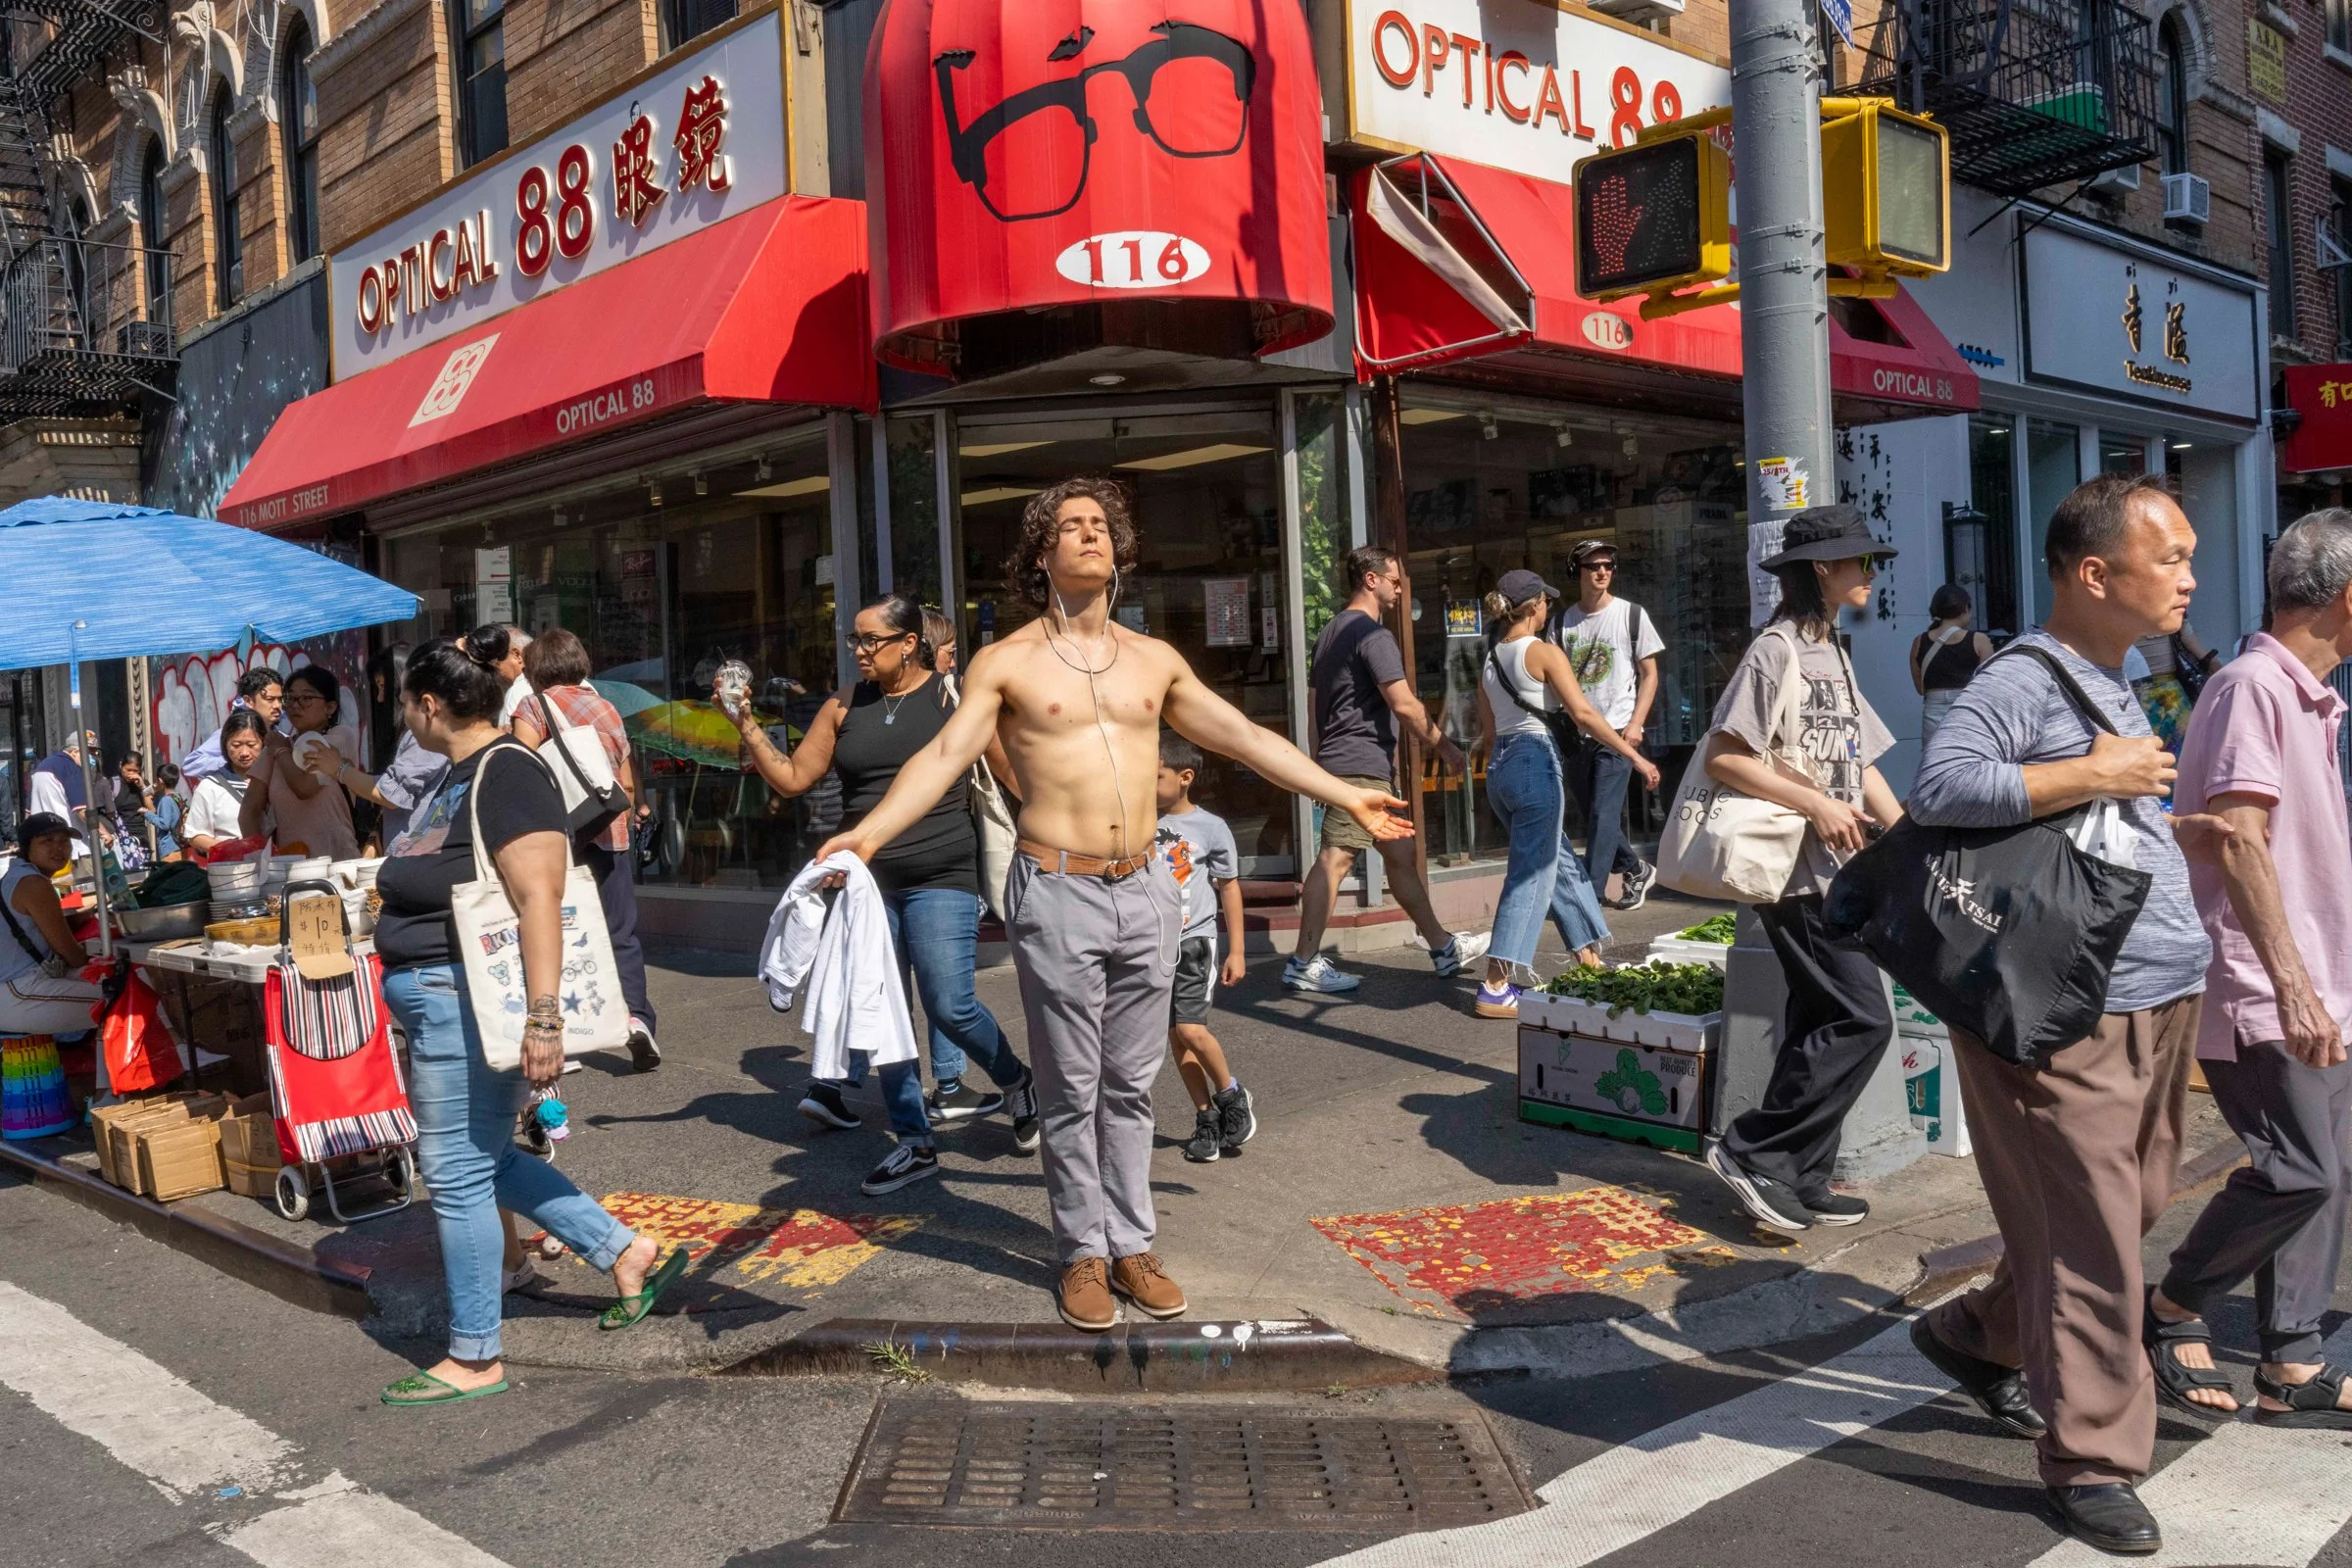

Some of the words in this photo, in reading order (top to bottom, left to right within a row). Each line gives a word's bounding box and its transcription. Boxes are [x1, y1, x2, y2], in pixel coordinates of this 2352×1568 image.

[1372, 10, 1595, 139] OPTICAL
[612, 74, 733, 227] 眼鏡
[357, 209, 502, 333] OPTICAL
[515, 144, 597, 276] 88
[1080, 238, 1189, 282] 116
[2126, 262, 2136, 277] si
[2168, 276, 2179, 295] yi
[1592, 318, 1624, 344] 116
[1874, 368, 1934, 398] OPTICAL
[1936, 378, 1953, 400] 88
[556, 389, 628, 434] OPTICAL
[632, 379, 655, 409] 88
[239, 506, 256, 526] 116
[259, 497, 286, 521] MOTT
[293, 484, 328, 514] STREET
[1684, 785, 1732, 805] UBIC
[316, 917, 328, 939] 10
[1967, 900, 2003, 927] TSAI
[567, 1027, 594, 1036] INDIGO
[1659, 1055, 1672, 1064] BEST
[1674, 1057, 1696, 1066] QUALITY
[1660, 1062, 1696, 1077] PRODUCE
